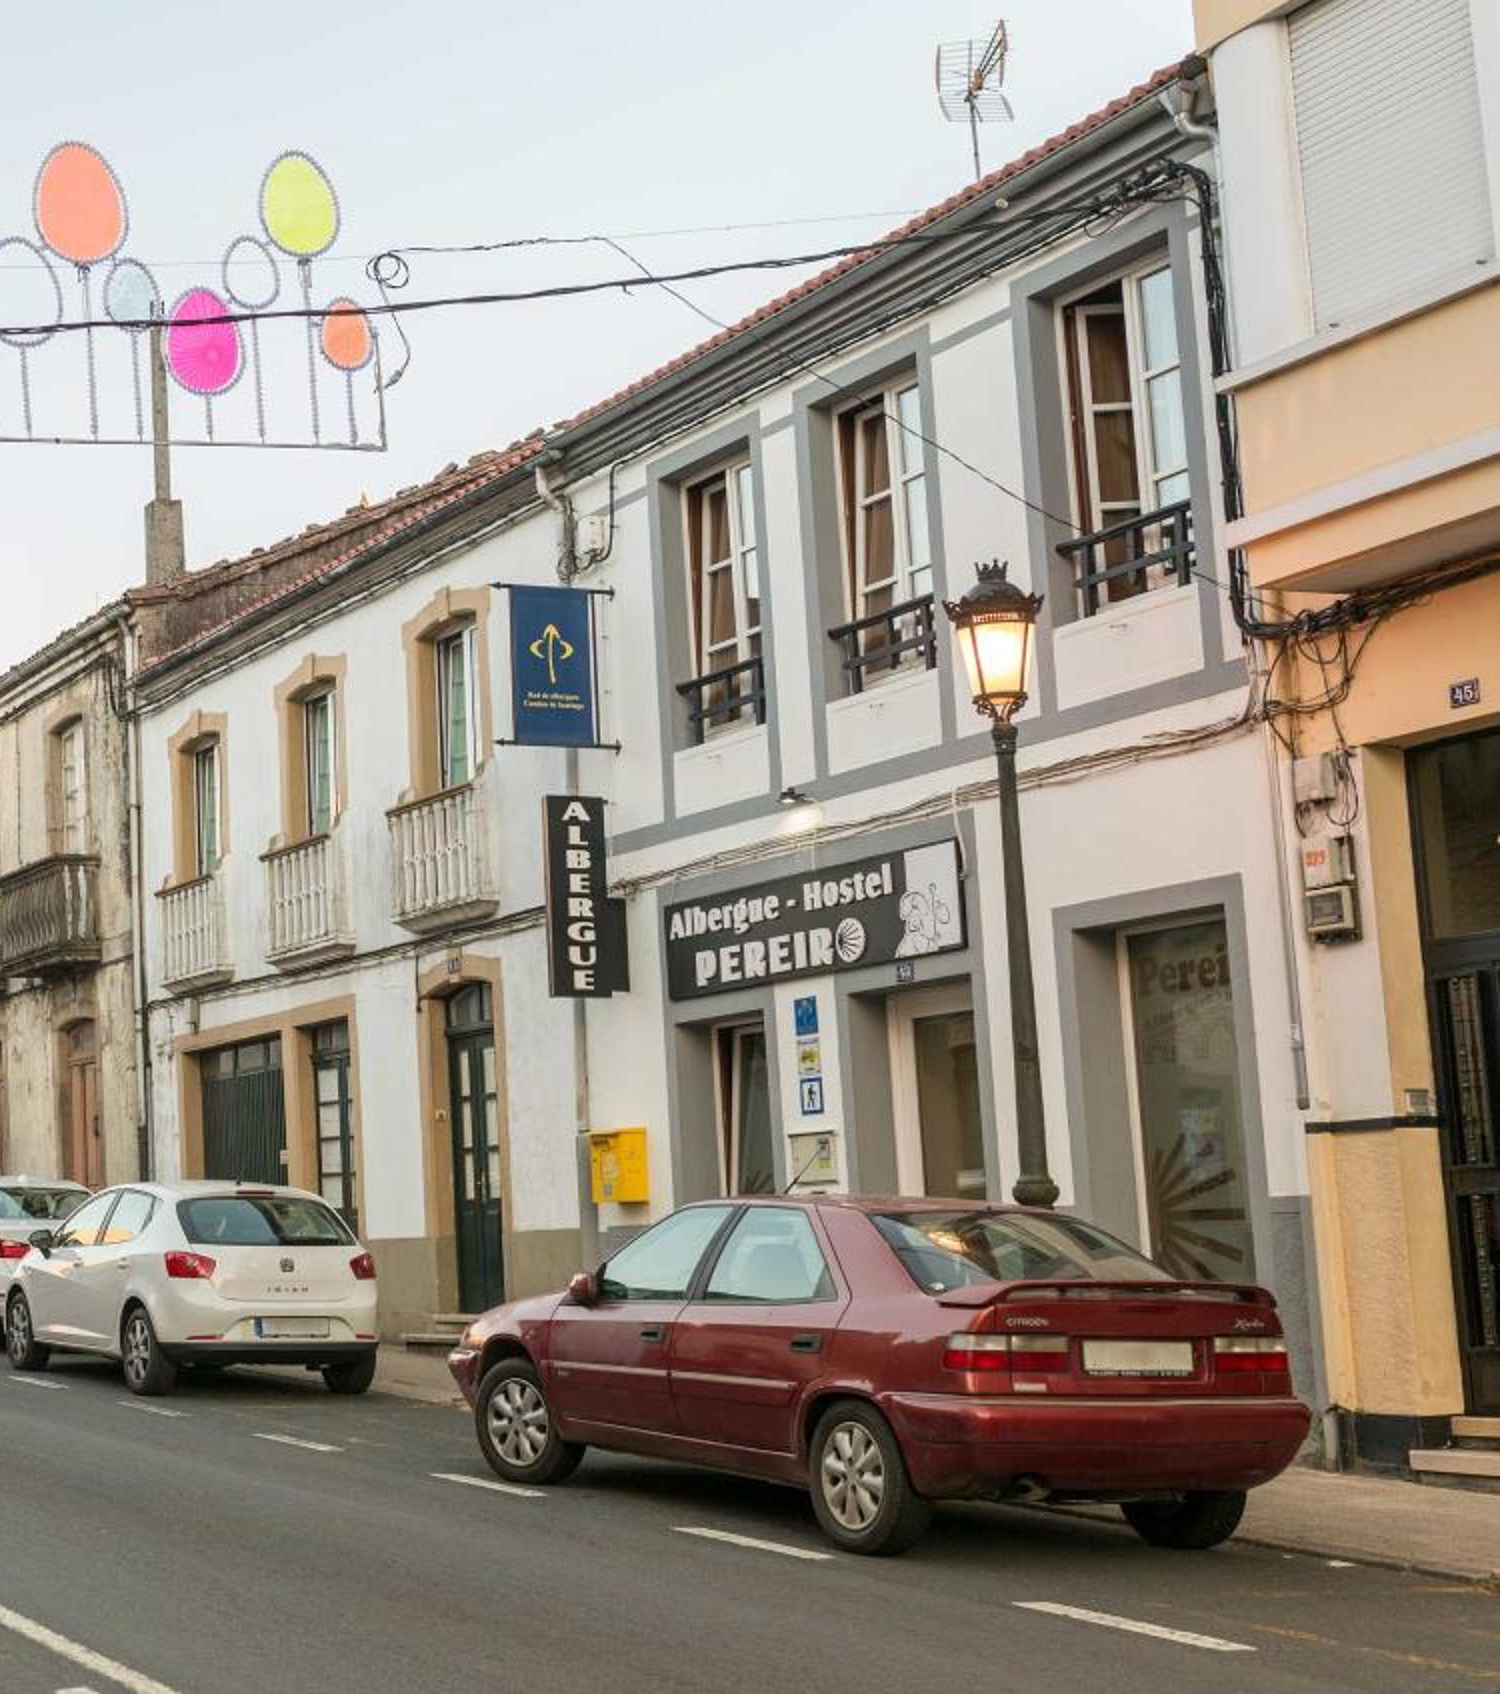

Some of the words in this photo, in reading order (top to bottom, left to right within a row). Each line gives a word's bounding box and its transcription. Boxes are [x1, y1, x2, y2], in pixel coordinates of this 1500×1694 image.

[1453, 685, 1474, 704] 45
[562, 801, 597, 991] ALBERGUE
[669, 894, 779, 941] Albergue
[803, 863, 894, 911] Hostel
